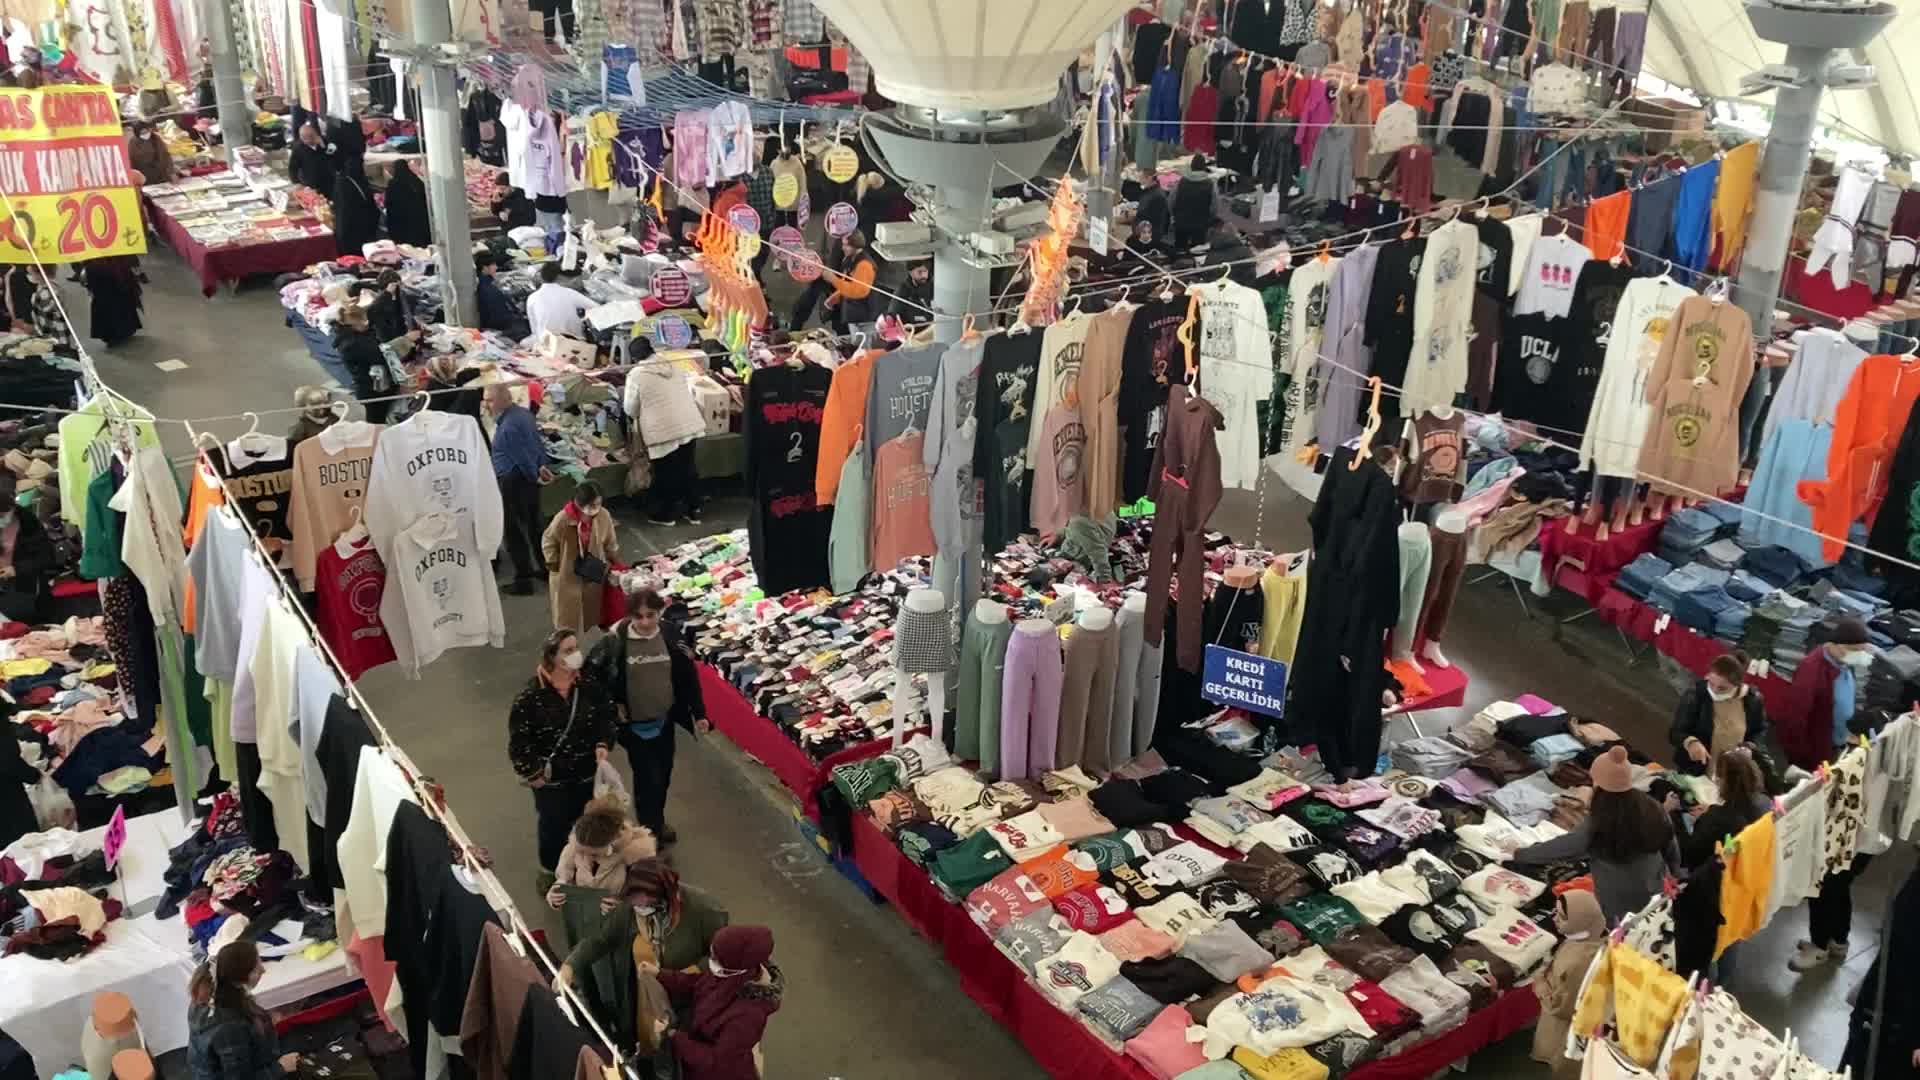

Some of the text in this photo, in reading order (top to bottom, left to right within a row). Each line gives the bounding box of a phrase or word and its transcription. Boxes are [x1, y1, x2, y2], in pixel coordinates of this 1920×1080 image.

[36, 145, 129, 193] KAMPANYA
[407, 448, 467, 477] OXFORD
[415, 548, 466, 583] OXFORD
[1225, 671, 1264, 690] KARTI
[1226, 656, 1265, 676] KREDİ
[1205, 682, 1281, 711] GEÇERLİDİR
